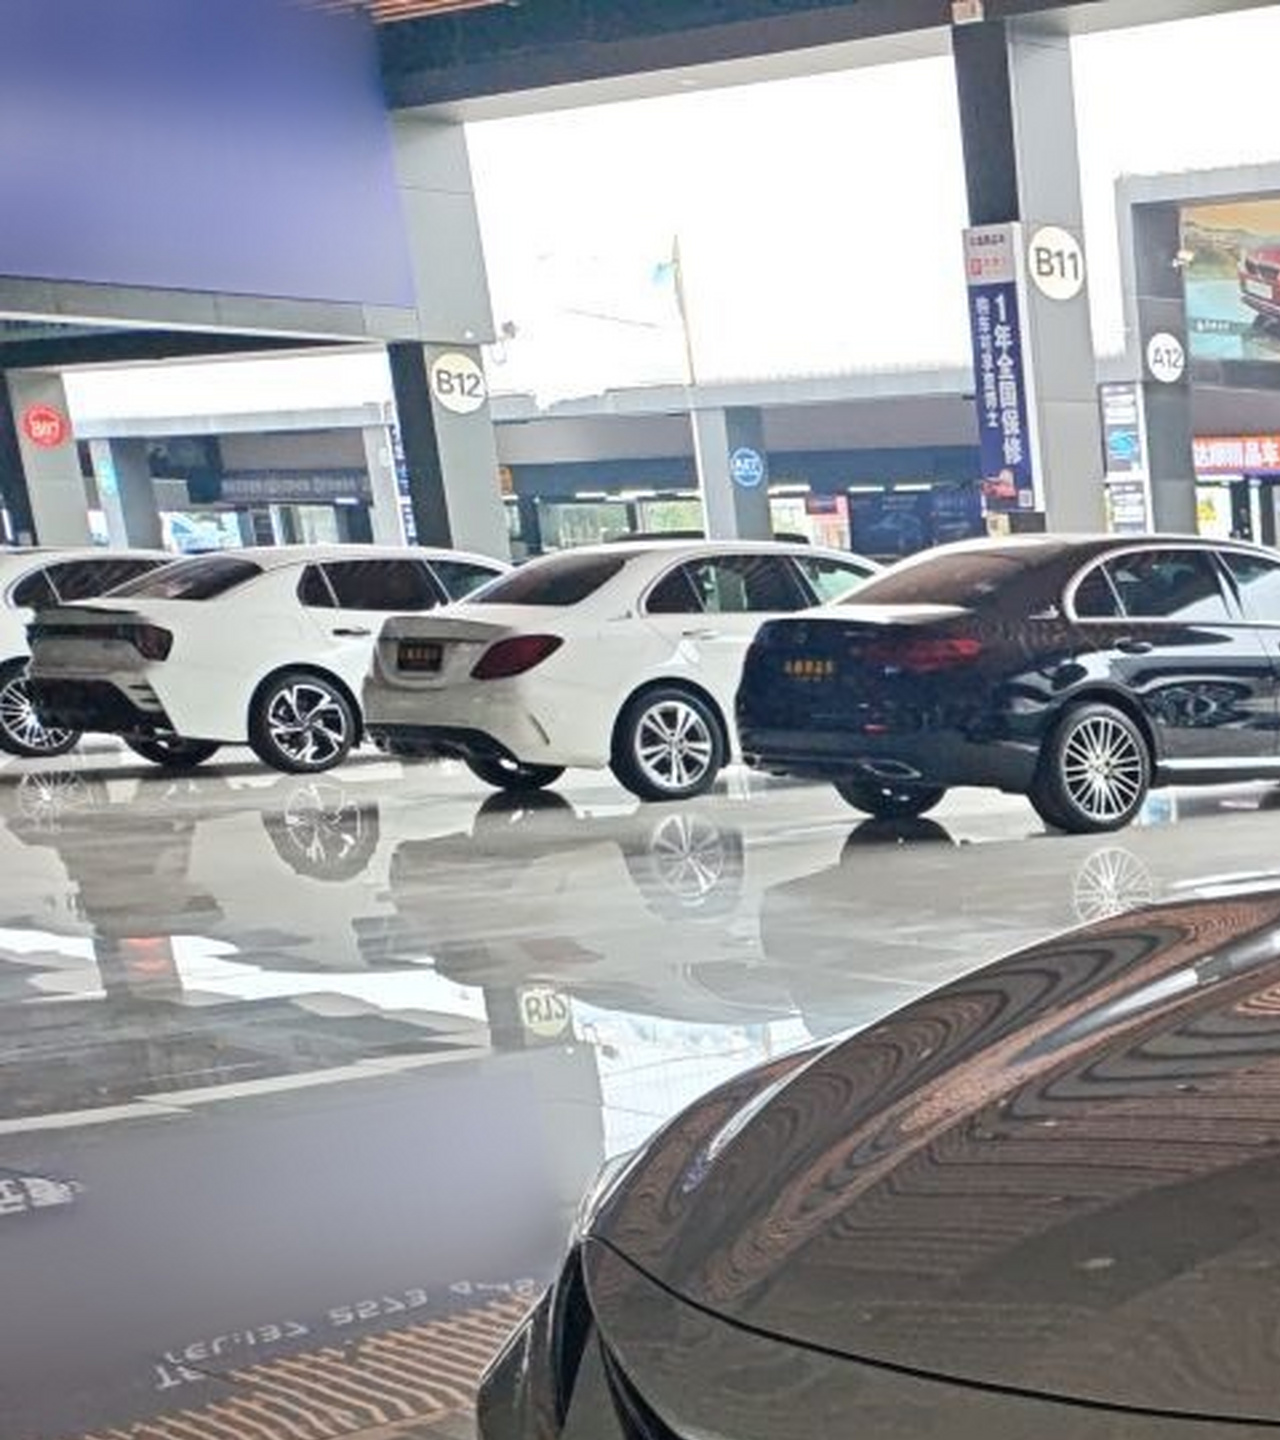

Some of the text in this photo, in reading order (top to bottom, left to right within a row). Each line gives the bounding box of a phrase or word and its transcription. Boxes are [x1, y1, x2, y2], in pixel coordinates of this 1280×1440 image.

[1034, 246, 1079, 281] B11
[1152, 346, 1183, 369] A12
[435, 369, 483, 399] B12
